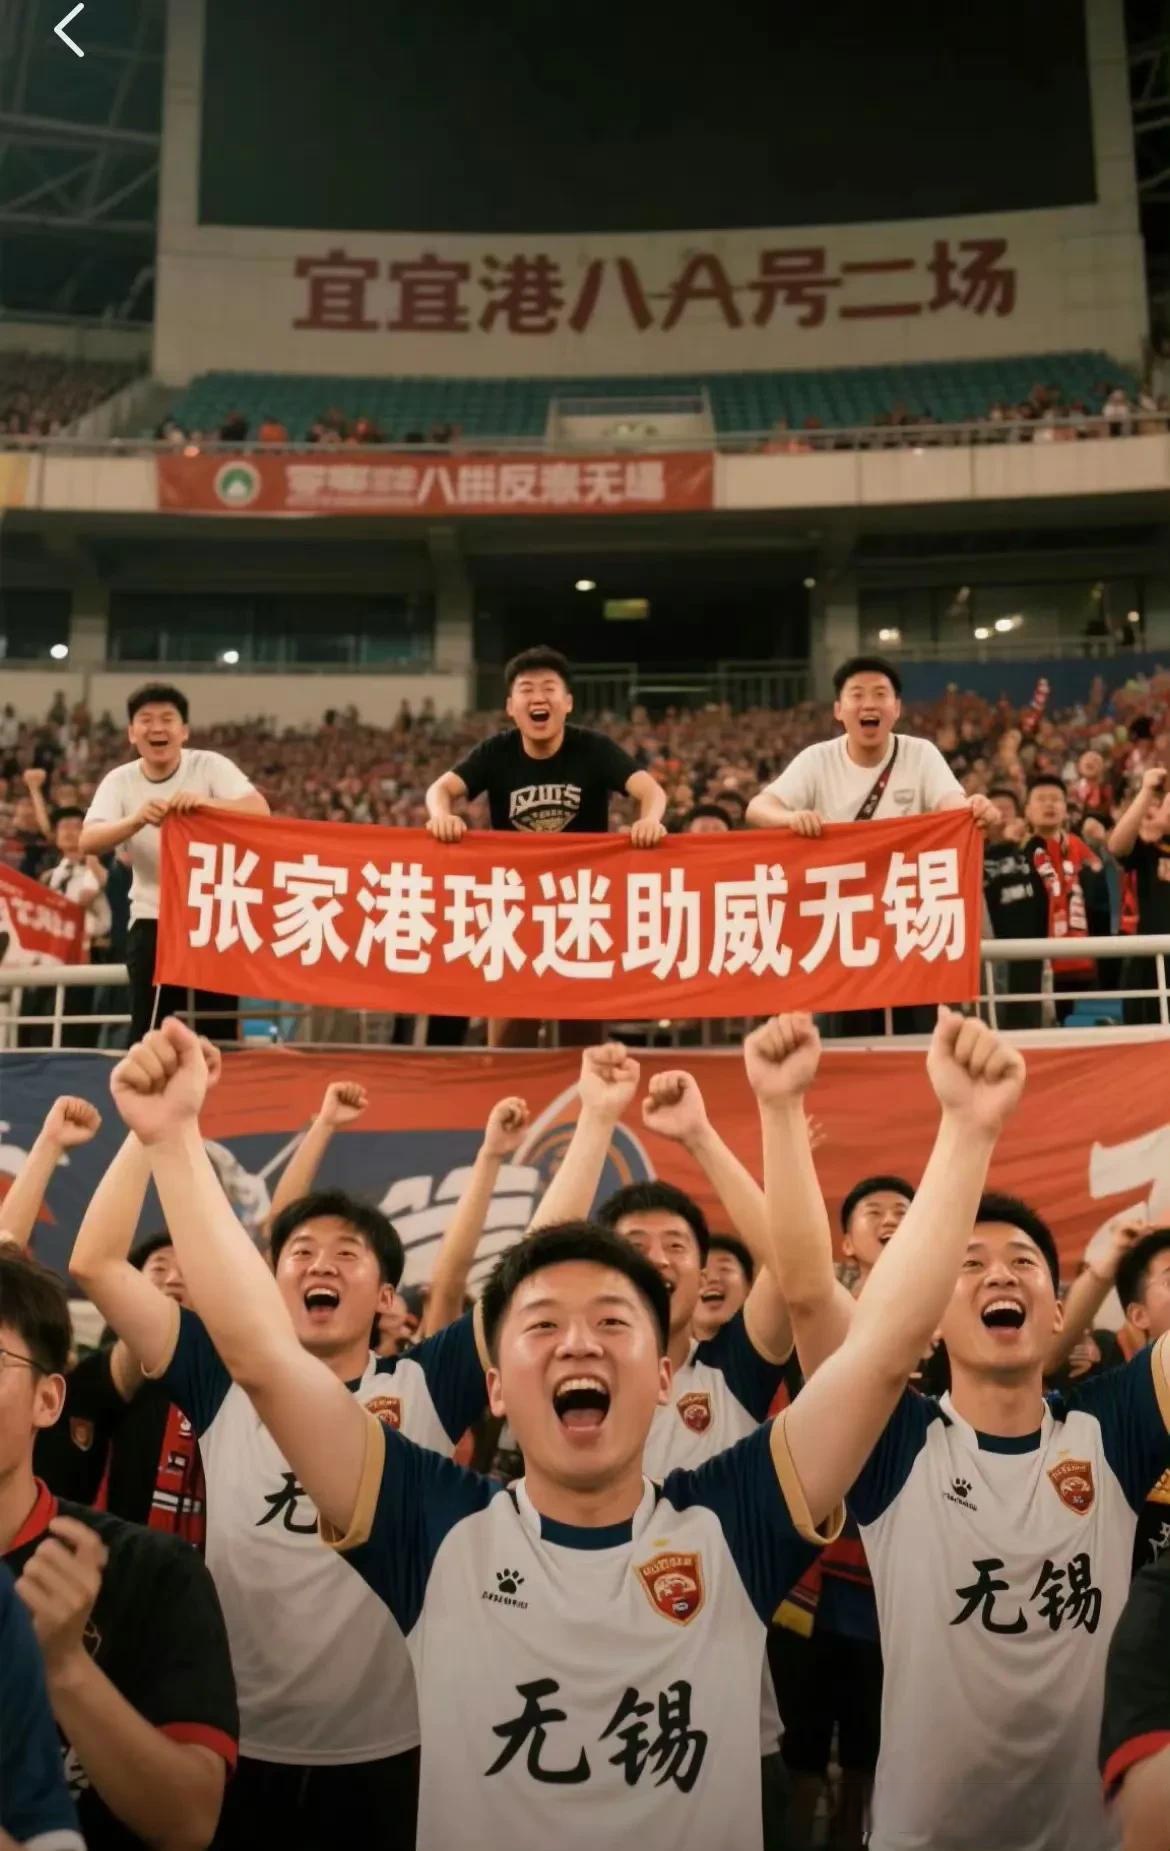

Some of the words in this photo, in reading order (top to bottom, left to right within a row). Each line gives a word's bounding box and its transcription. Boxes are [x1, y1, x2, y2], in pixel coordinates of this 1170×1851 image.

[187, 842, 966, 982] 张家港球迷助威无锡
[949, 1552, 1102, 1635] 无锡
[484, 1678, 708, 1794] 无锡
